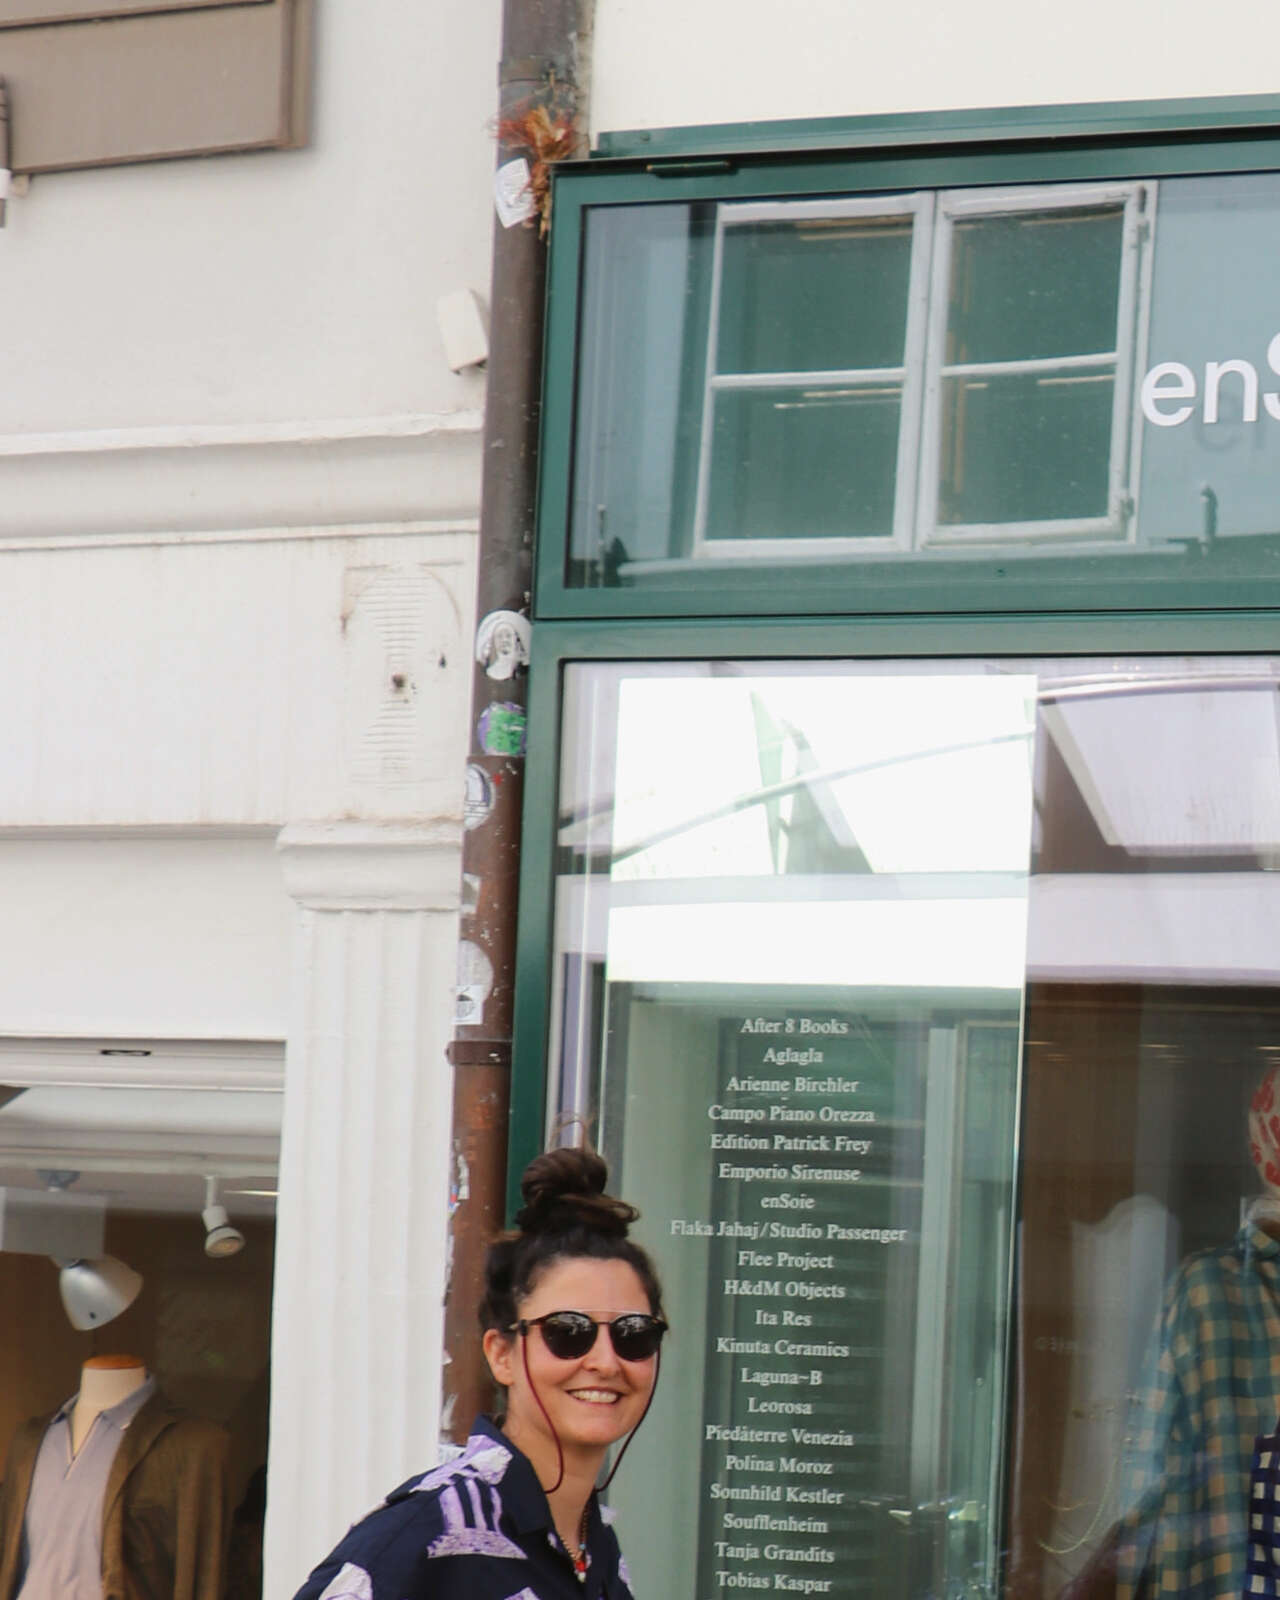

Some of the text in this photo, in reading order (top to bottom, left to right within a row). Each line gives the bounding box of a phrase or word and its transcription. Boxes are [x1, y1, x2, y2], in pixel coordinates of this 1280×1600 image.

[740, 1017, 849, 1034] After 8 Books
[763, 1047, 823, 1066] Aglagla
[726, 1076, 859, 1093] Arienne Birchler
[708, 1105, 876, 1123] Campo Piano Orezza
[710, 1133, 872, 1155] Edition Patrick Frey
[719, 1163, 861, 1182] Emporio Sirenuse
[761, 1193, 815, 1209] enSoie
[670, 1219, 714, 1236] Flaka
[826, 1223, 908, 1243] Passenger
[738, 1250, 834, 1271] Flee Project
[724, 1280, 846, 1300] H&dM Objects
[755, 1309, 812, 1327] Ita Res
[717, 1337, 850, 1357] Kinuta Ceramics
[747, 1397, 813, 1415] Leorosa
[791, 1427, 854, 1446] Venezia
[725, 1454, 834, 1475] Polina Moroz
[710, 1483, 845, 1504] Sonnhild Kestler
[723, 1513, 828, 1533] Soufflenheim
[714, 1541, 836, 1563] Tanja Grandits
[715, 1571, 832, 1594] Tobias Kaspar
